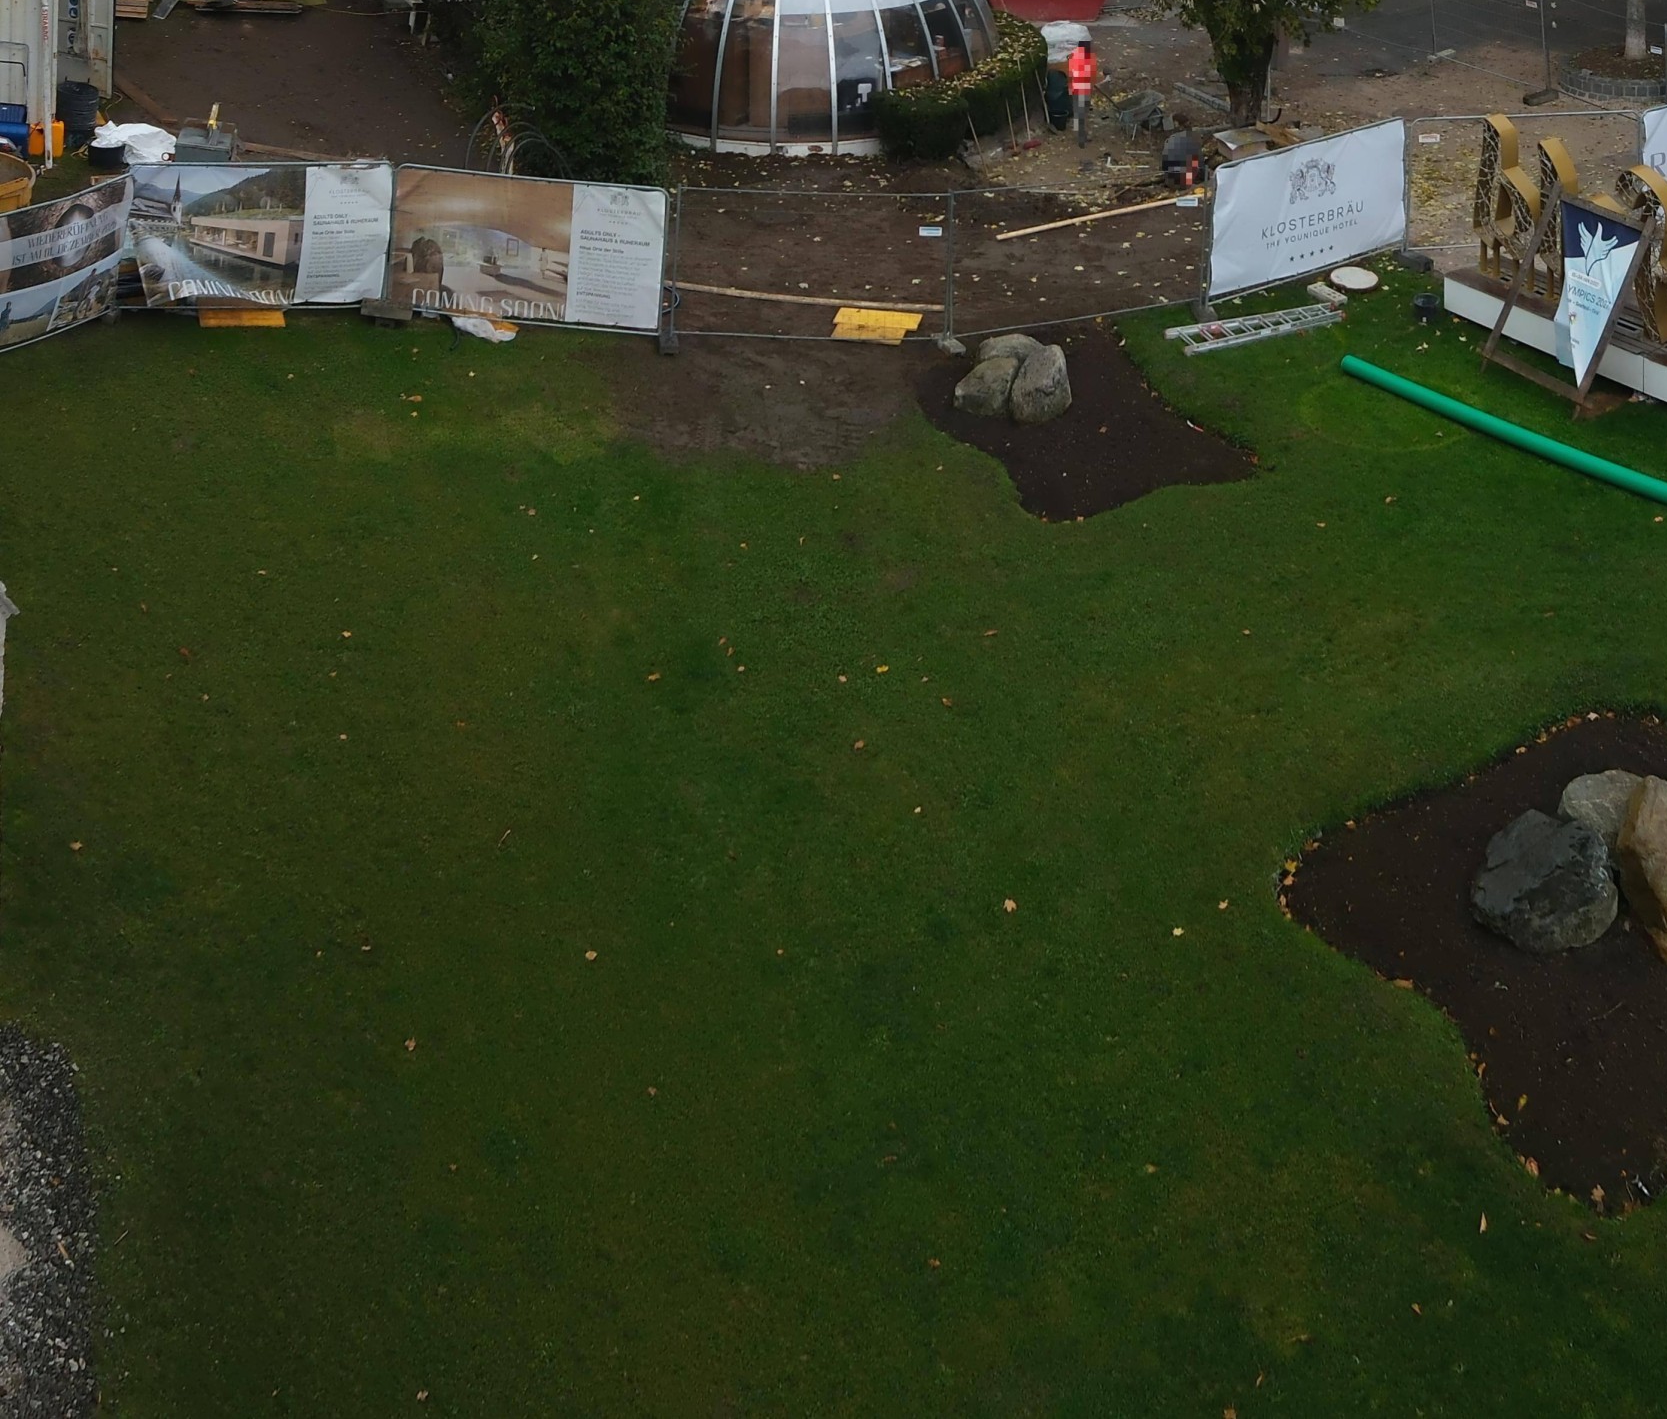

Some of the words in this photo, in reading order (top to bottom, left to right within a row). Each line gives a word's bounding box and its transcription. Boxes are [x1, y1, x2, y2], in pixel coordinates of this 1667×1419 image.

[1261, 200, 1365, 240] KLOSTERBRÄU
[1266, 239, 1281, 250] THE
[1285, 226, 1330, 245] YOUNIQUE
[1333, 219, 1358, 234] HOTEL
[412, 288, 493, 313] COMING
